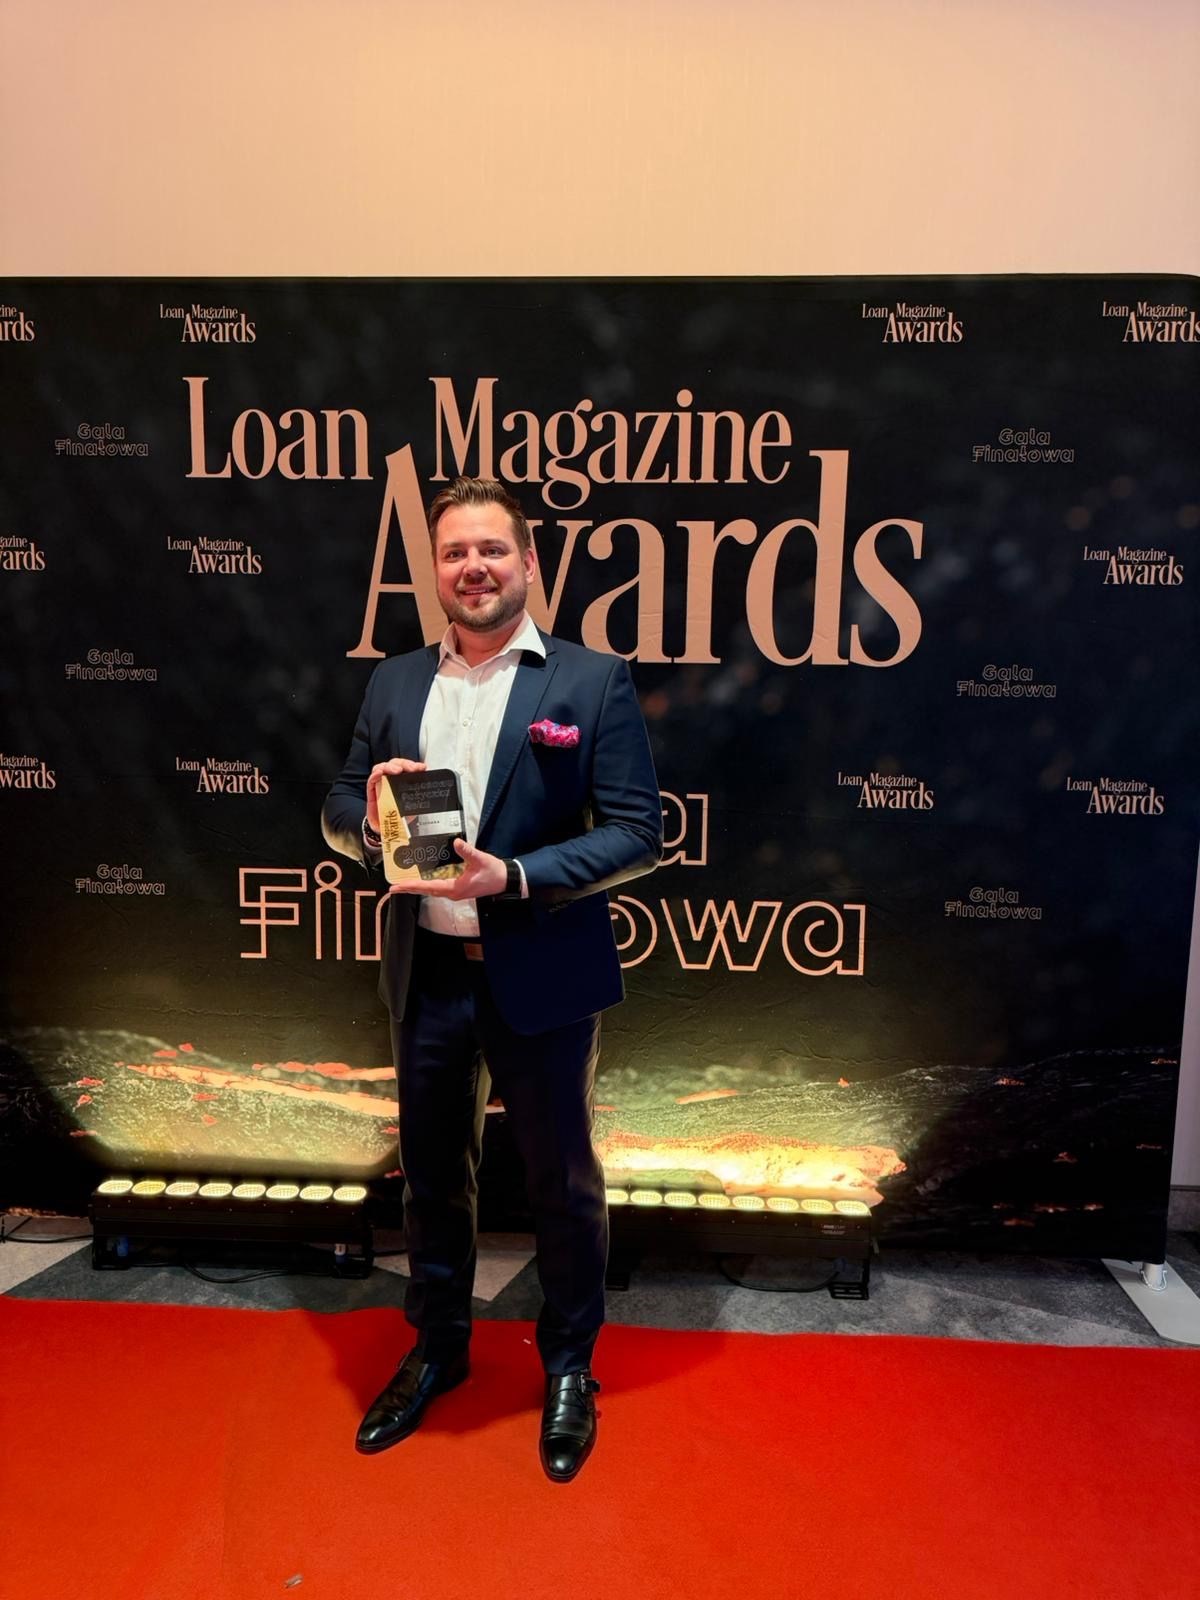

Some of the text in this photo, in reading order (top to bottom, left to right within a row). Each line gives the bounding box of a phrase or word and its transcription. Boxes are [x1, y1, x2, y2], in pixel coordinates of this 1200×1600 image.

[159, 303, 238, 321] Loan Magazine
[862, 302, 945, 320] Loan Magazine
[1102, 301, 1188, 320] Loan Magazine
[0, 311, 36, 342] rds
[181, 312, 256, 343] Awards
[883, 311, 963, 343] Awards
[78, 422, 125, 440] Gala
[999, 427, 1050, 446] Gala
[182, 376, 792, 511] Loan Magazine
[0, 535, 28, 550] azine
[167, 536, 245, 553] Loan Magazine
[0, 542, 46, 571] ards
[188, 545, 262, 574] Awards
[1083, 545, 1167, 564] Loan Magazine
[1104, 555, 1183, 585] Awards
[87, 648, 134, 666] Gala
[983, 664, 1034, 683] Gala
[175, 756, 252, 774] Loan Magazine
[0, 762, 56, 790] wards
[197, 766, 269, 794] Awards
[837, 771, 917, 789] Loan Magazine
[1066, 776, 1148, 794] Loan Magazine
[858, 781, 934, 810] Awards
[1086, 786, 1164, 815] Awards
[402, 840, 451, 865] 2026
[97, 863, 142, 882] Gala
[969, 886, 1019, 905] Gala
